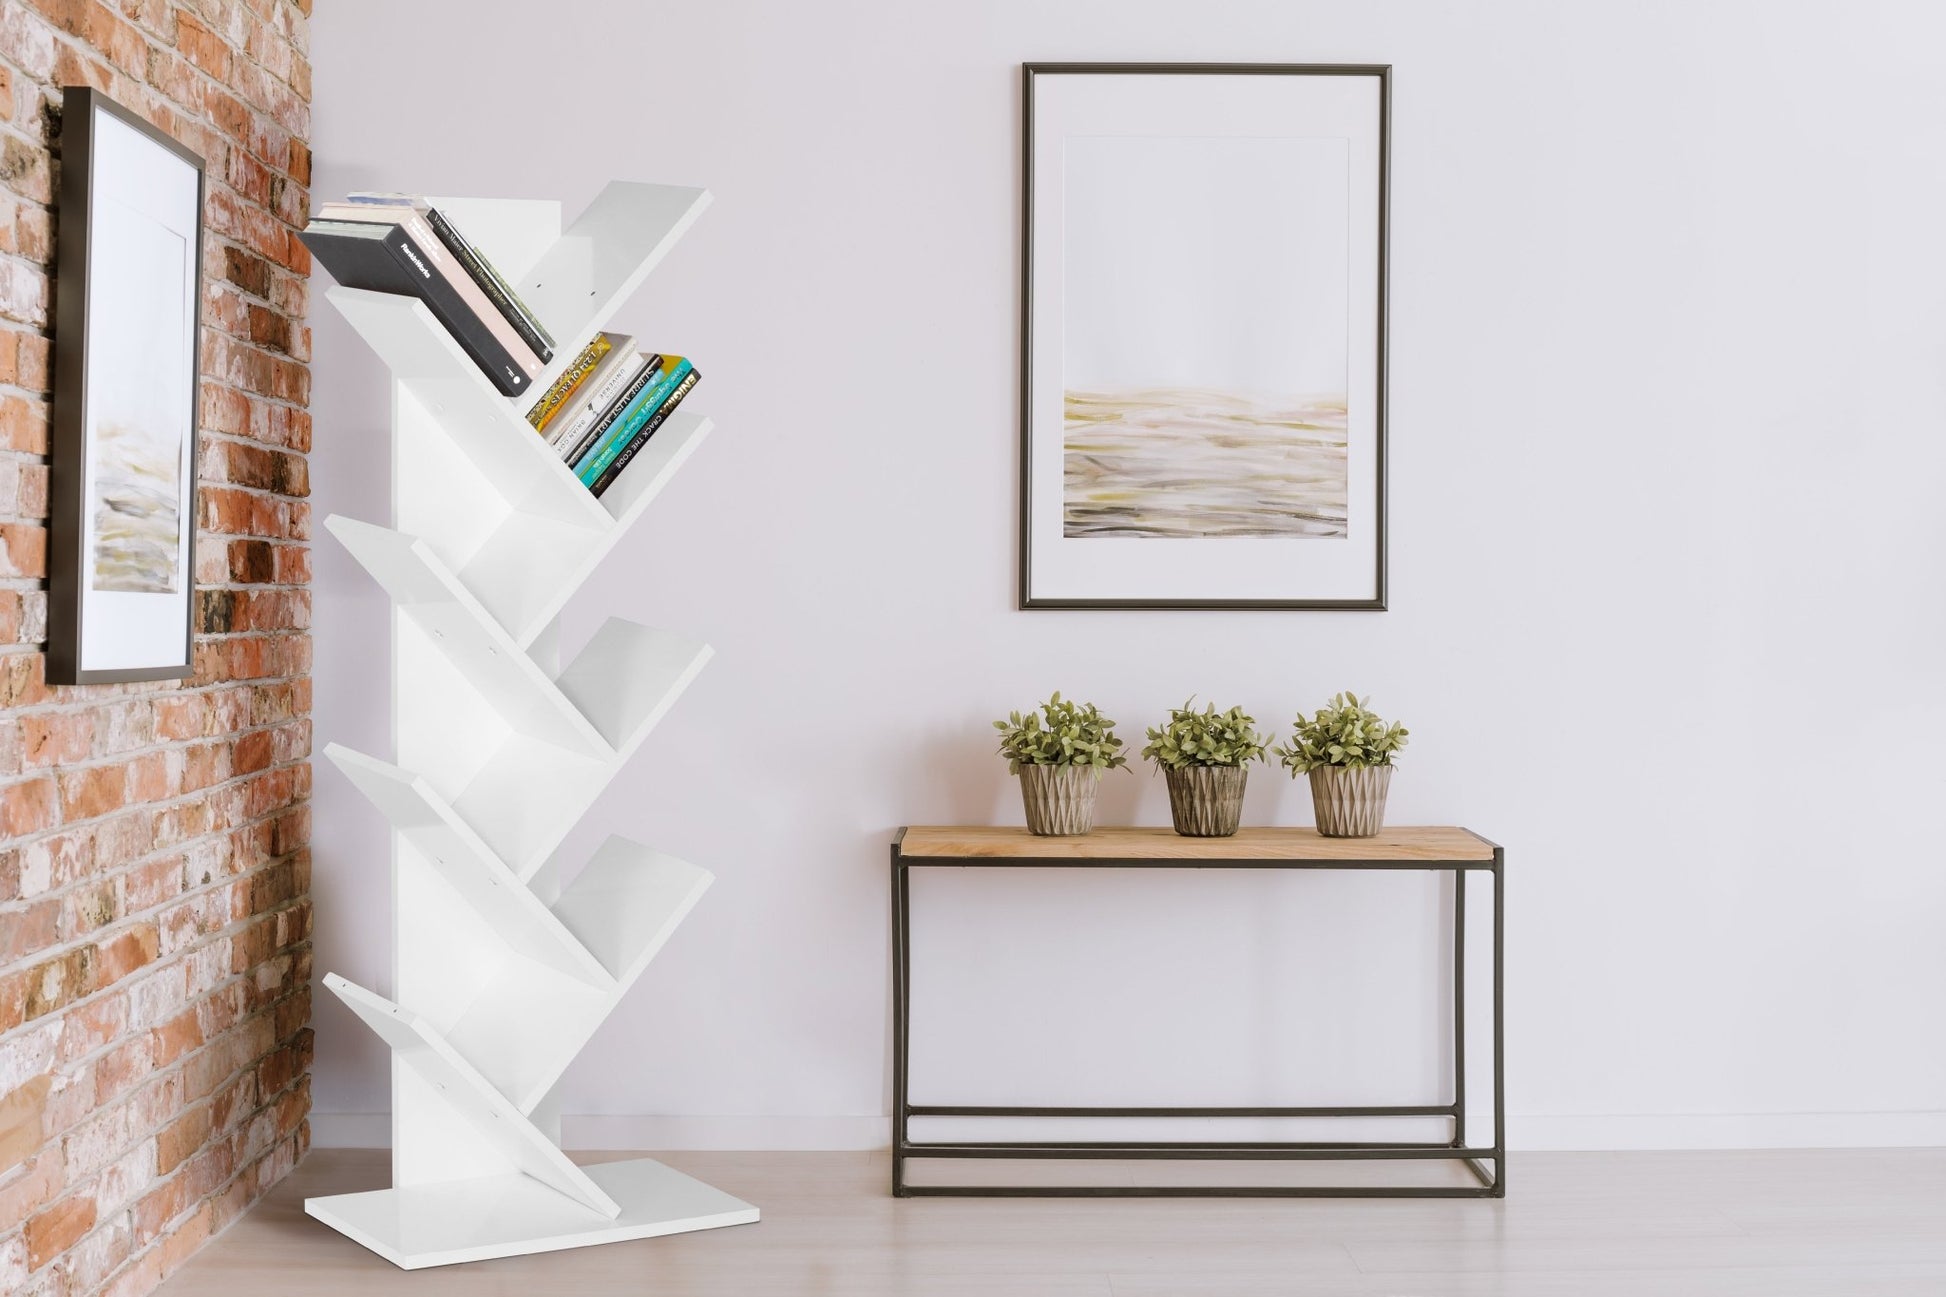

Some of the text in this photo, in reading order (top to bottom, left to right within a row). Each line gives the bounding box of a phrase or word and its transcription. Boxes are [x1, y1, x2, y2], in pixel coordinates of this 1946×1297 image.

[431, 214, 508, 306] Vivian Maier Street Photographer
[550, 379, 573, 406] FACTS
[609, 367, 655, 418] SURREALIST
[596, 414, 613, 436] ART
[641, 414, 662, 438] CRACK
[630, 435, 643, 451] THE
[614, 448, 633, 469] CODE
